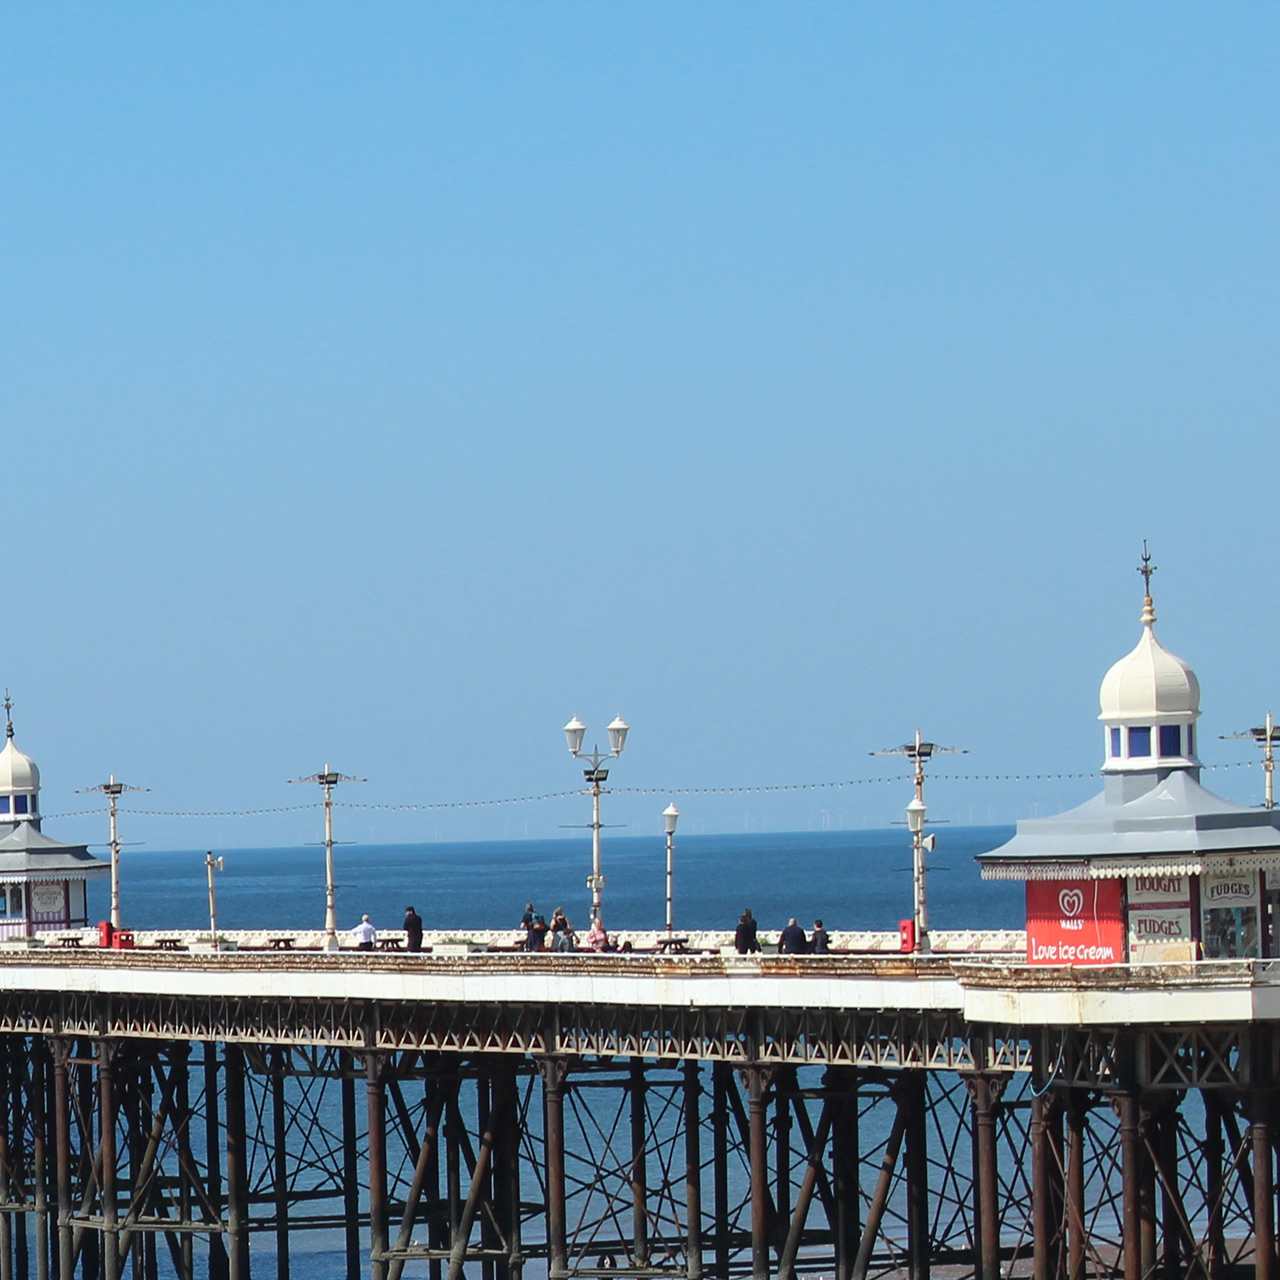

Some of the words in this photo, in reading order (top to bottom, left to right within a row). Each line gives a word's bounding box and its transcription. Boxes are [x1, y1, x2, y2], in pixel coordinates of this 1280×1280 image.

[1134, 876, 1182, 893] NOUGAT
[1210, 882, 1251, 899] FUDGES
[1137, 918, 1182, 936] FUDGES
[1032, 937, 1057, 960] Love
[1058, 941, 1076, 959] ice
